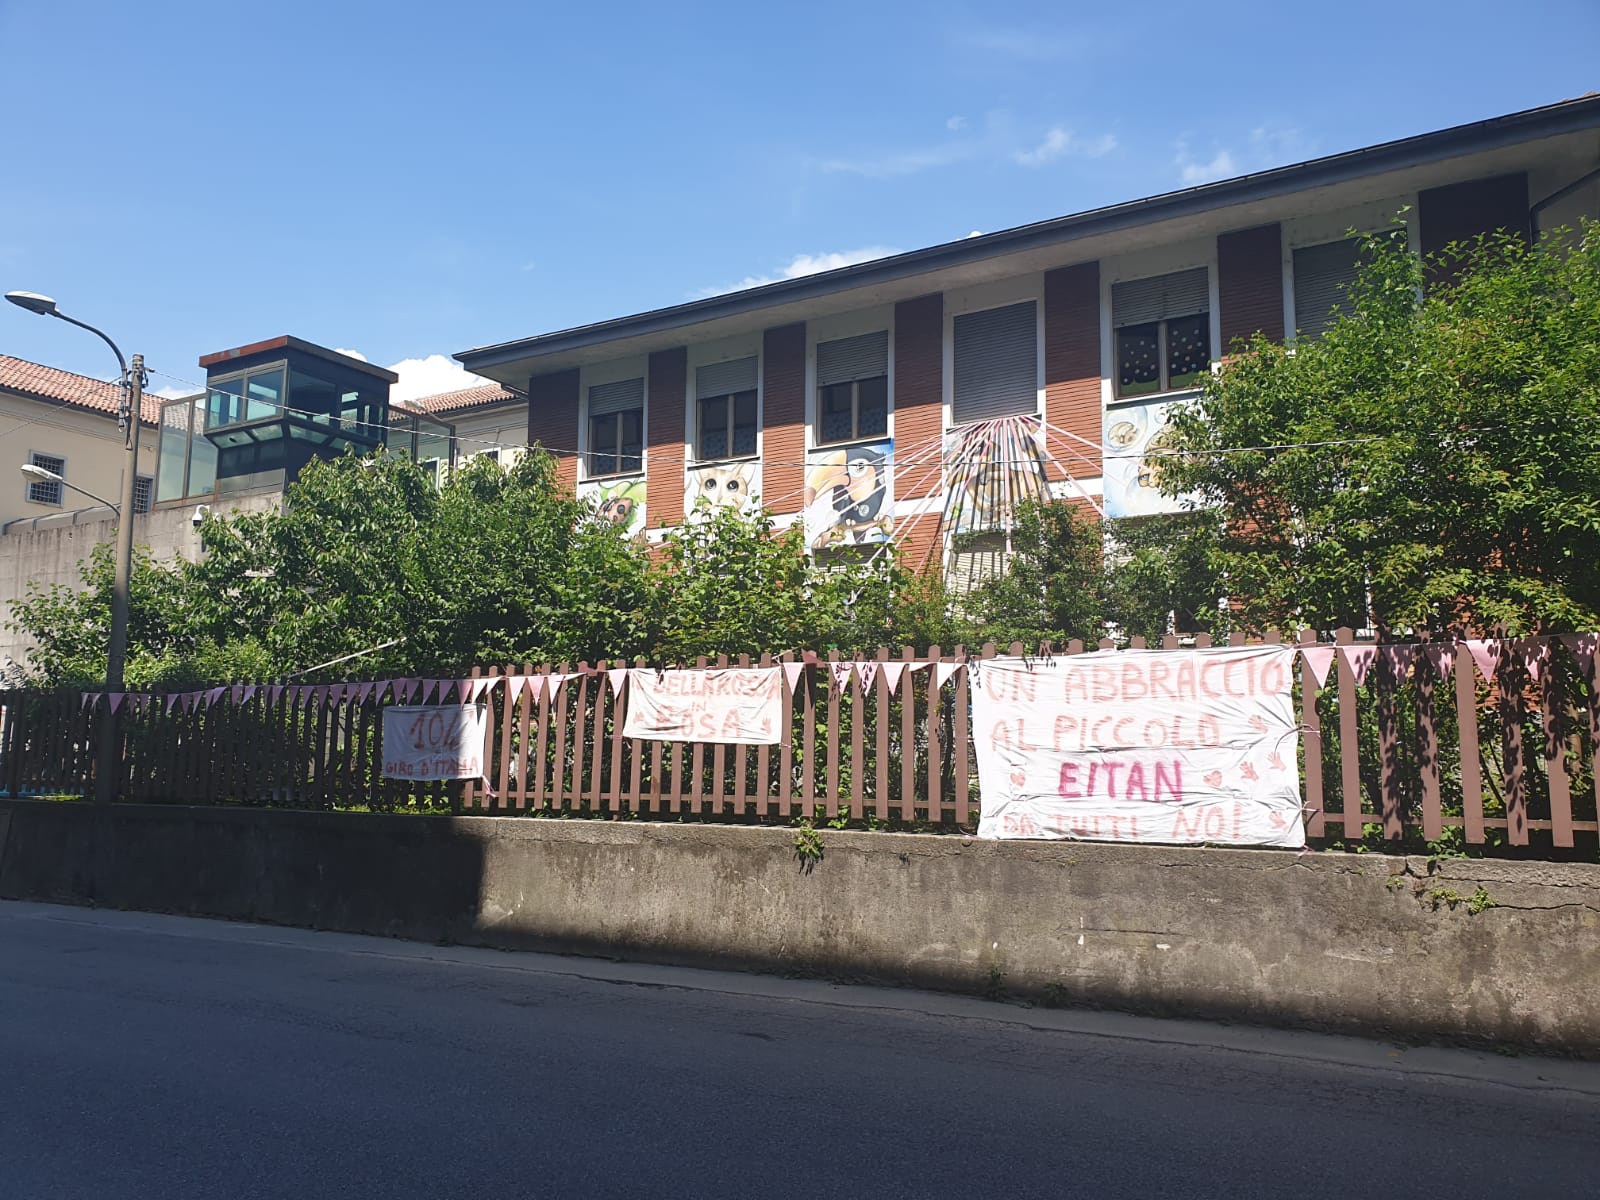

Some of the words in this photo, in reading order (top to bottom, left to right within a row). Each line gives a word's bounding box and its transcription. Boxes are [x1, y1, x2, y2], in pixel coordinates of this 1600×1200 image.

[985, 668, 1038, 702] UN
[1064, 658, 1284, 704] ABBRACCIO
[991, 718, 1038, 752] AL
[1053, 713, 1221, 752] PICCOLO
[385, 761, 413, 777] GIRO
[1057, 760, 1184, 802] EITAN
[1002, 814, 1036, 836] DA
[1052, 814, 1139, 839] TUTTI
